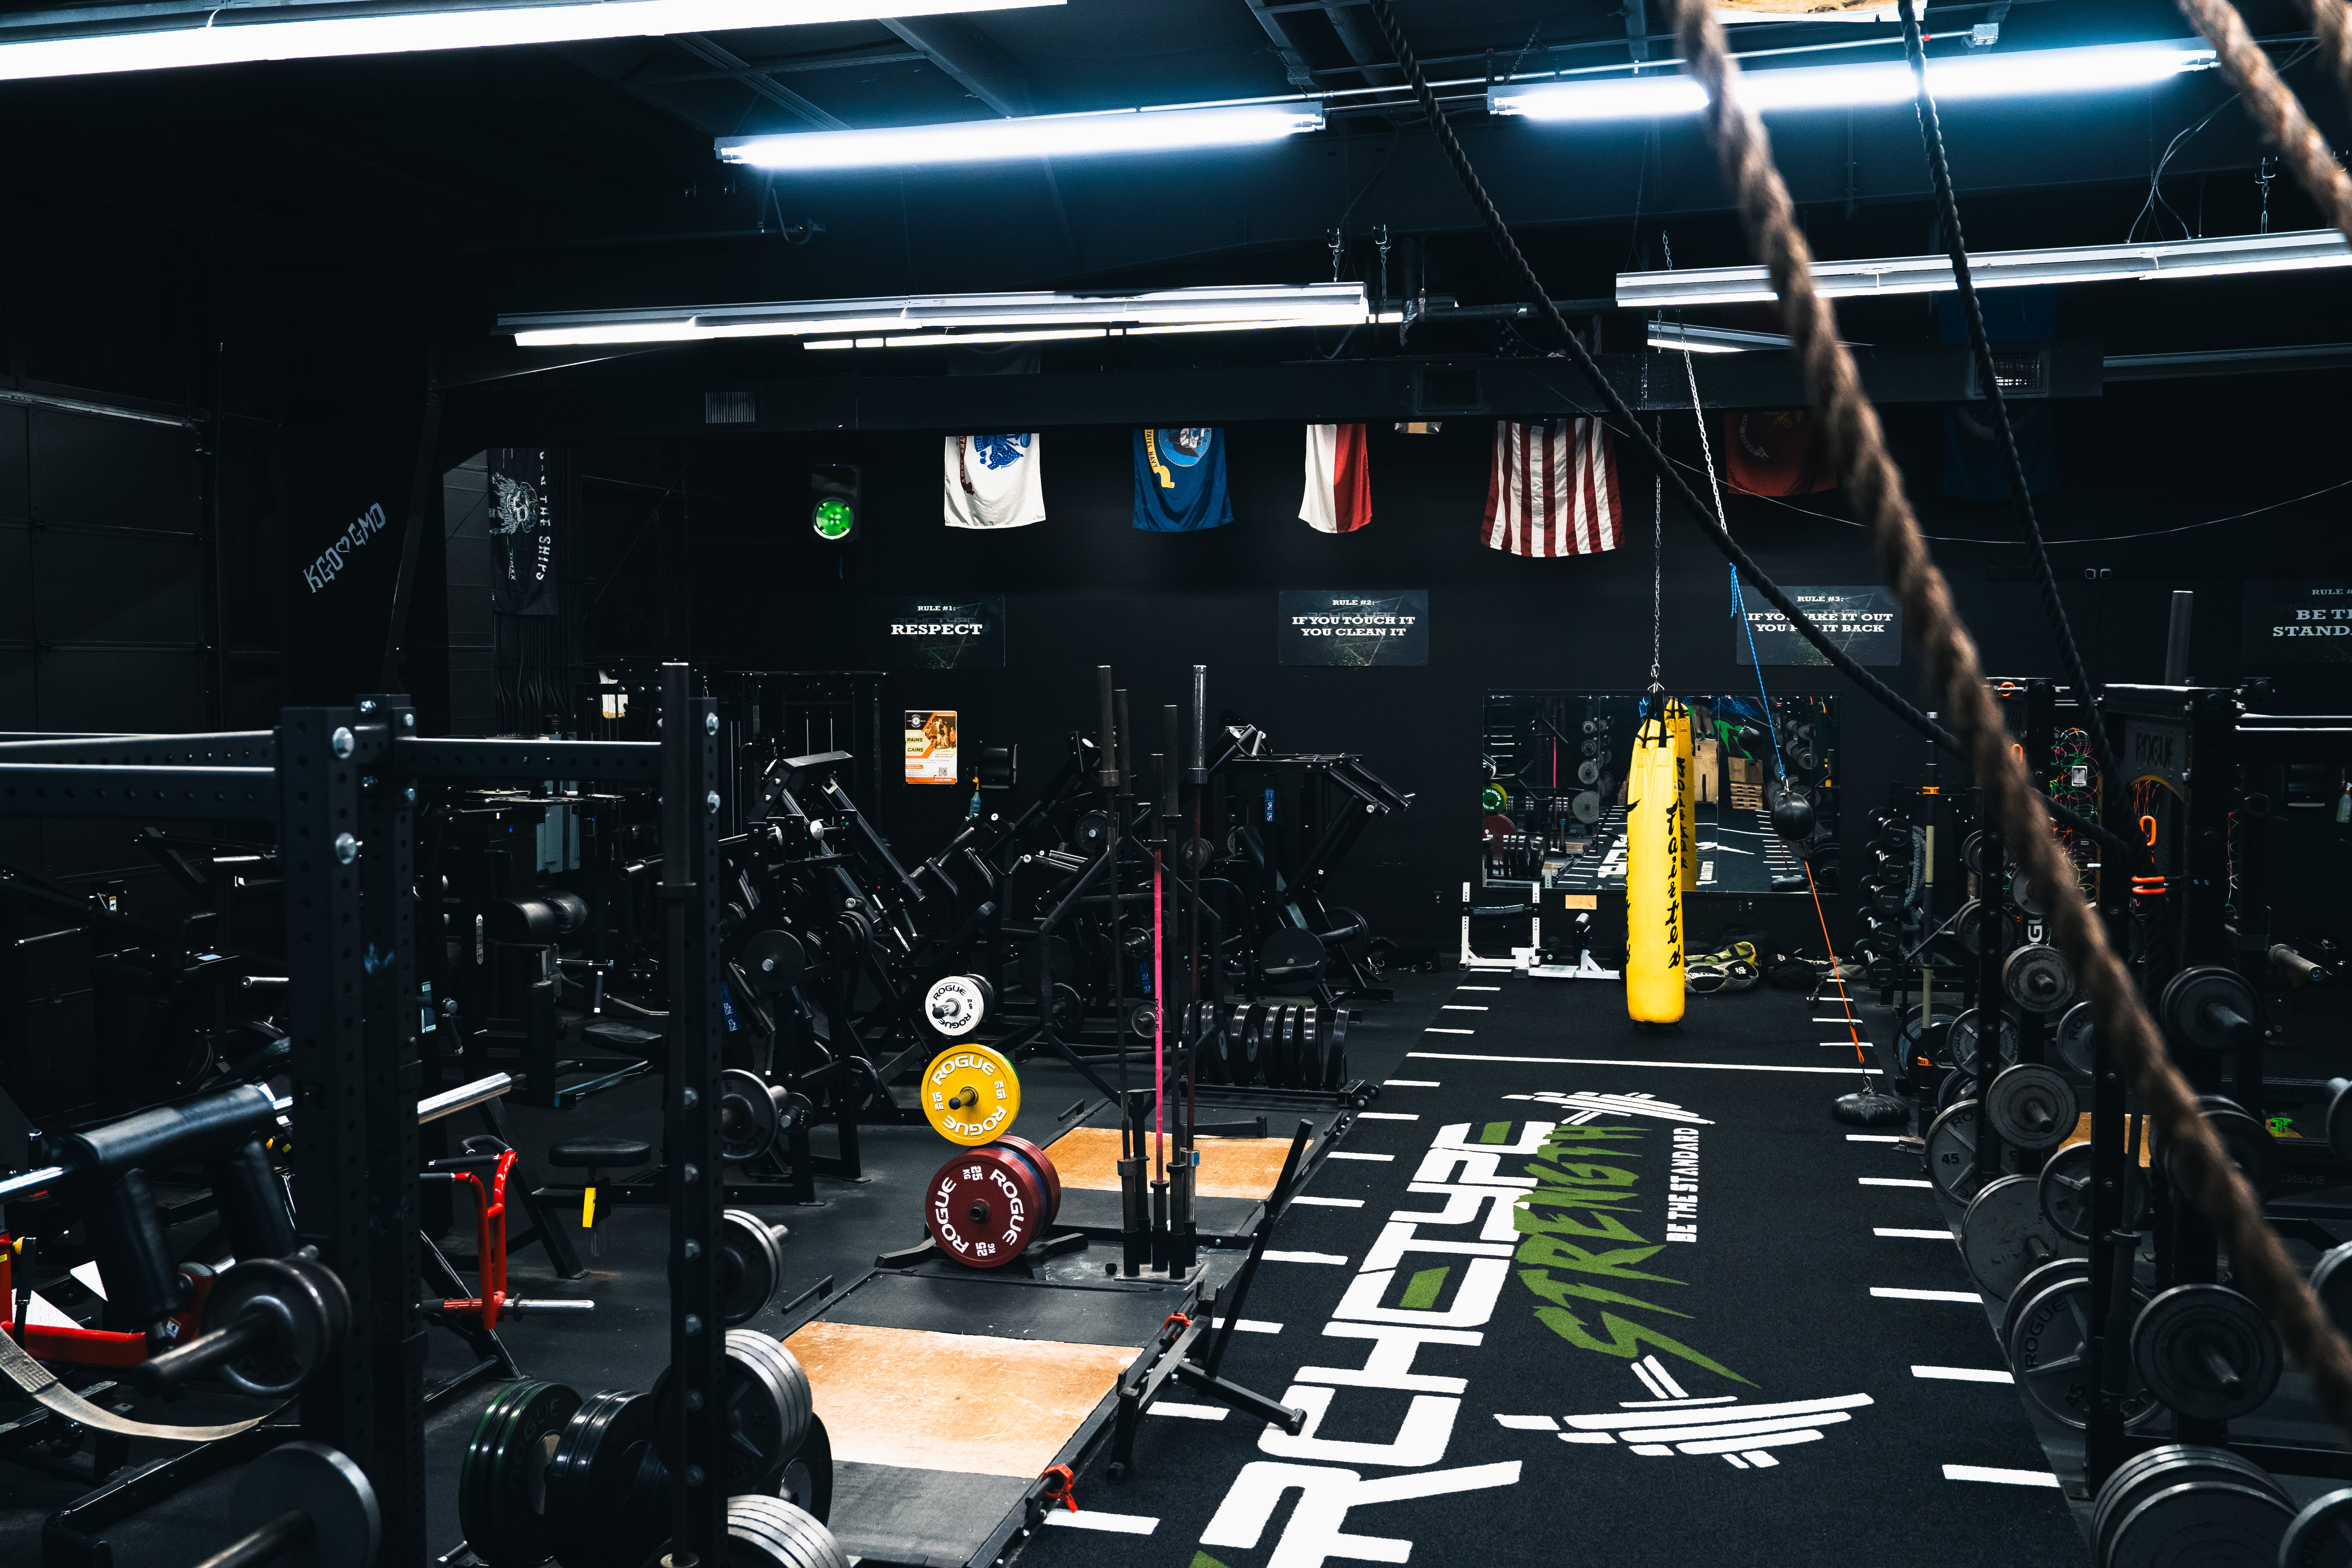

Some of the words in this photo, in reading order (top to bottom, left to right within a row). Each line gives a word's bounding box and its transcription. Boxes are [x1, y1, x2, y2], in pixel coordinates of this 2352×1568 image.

[1149, 451, 1158, 468] NAVY
[540, 495, 550, 526] THE
[2296, 610, 2326, 620] BE
[891, 624, 982, 635] RESPECT
[2273, 626, 2352, 637] STAND
[933, 985, 966, 1000] ROGUE
[938, 1013, 971, 1029] ROGUE
[1954, 1029, 1967, 1061] ROGUE
[2006, 1026, 2018, 1059] ROGUE
[932, 1055, 996, 1085] ROGUE
[931, 1092, 943, 1103] 15
[996, 1089, 1007, 1099] 15
[942, 1106, 1007, 1135] ROGUE
[1670, 1128, 1699, 1192] STANDARD
[1942, 1152, 1959, 1164] 45
[963, 1169, 971, 1180] KG
[971, 1166, 983, 1181] 25
[2281, 1174, 2324, 1184] OGUE
[989, 1169, 1024, 1245] ROGUE
[1668, 1194, 1698, 1219] THE
[935, 1177, 969, 1254] ROGUE
[1666, 1224, 1697, 1242] BE
[975, 1242, 988, 1256] 25
[987, 1243, 995, 1254] KG
[1513, 1125, 1761, 1388] STRENGTH
[2025, 1298, 2067, 1367] ROGUE
[1200, 1121, 1556, 1568] RCHETYPE
[2064, 1383, 2084, 1406] 45
